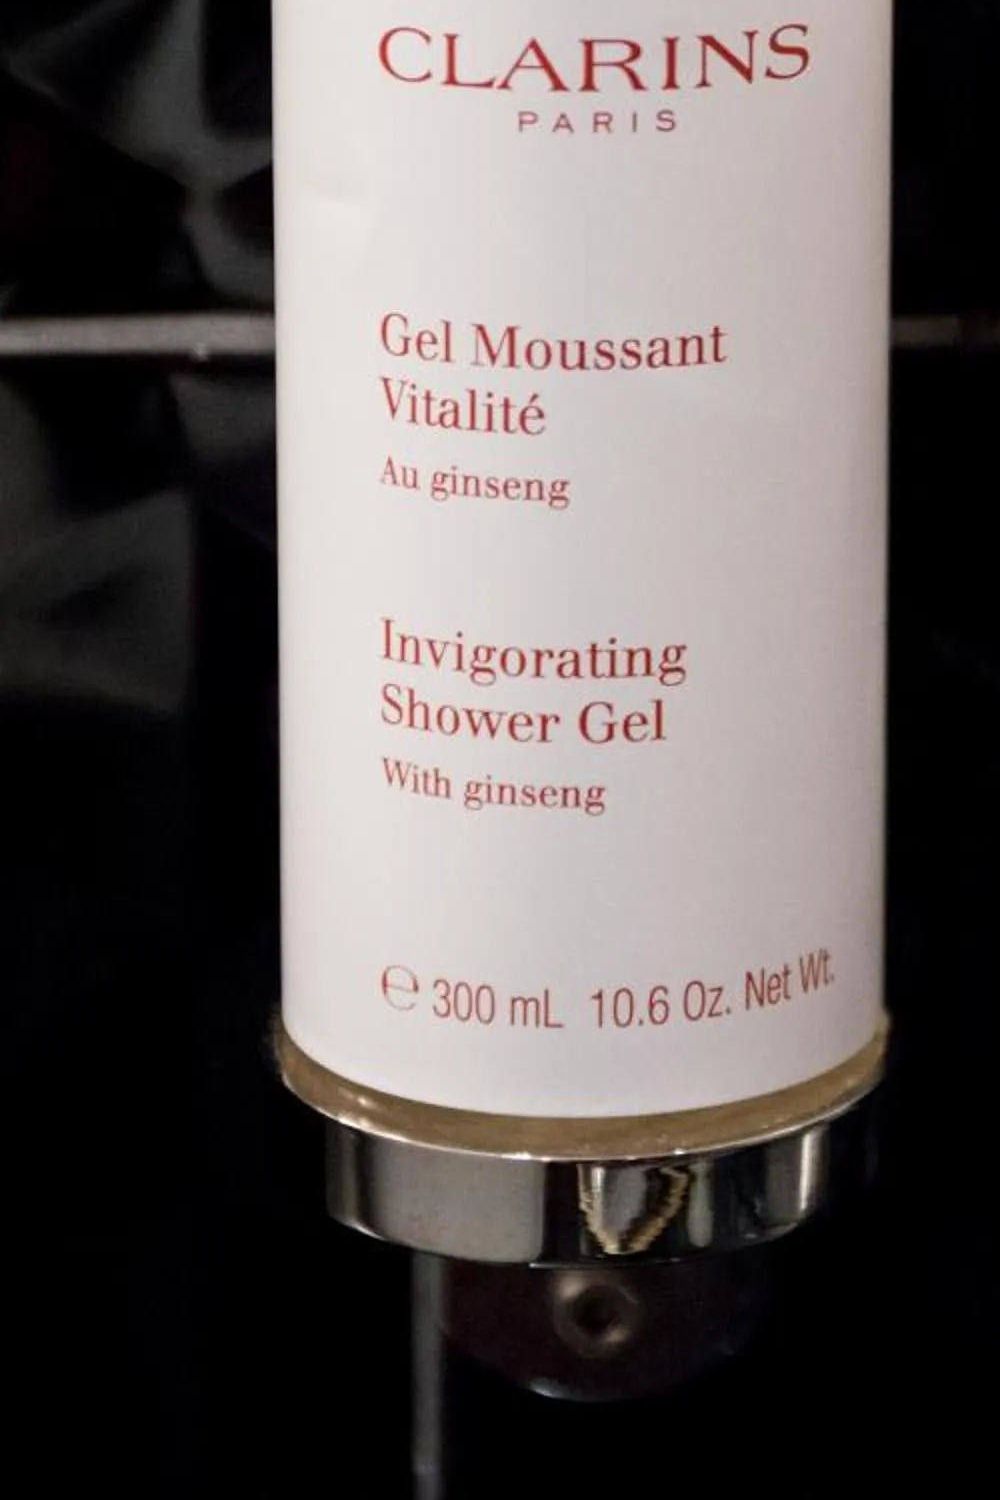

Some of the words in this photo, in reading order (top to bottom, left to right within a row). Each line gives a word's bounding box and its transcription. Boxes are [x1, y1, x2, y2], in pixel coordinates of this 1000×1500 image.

[378, 23, 811, 92] CLARINS
[518, 110, 678, 133] PARIS
[380, 313, 456, 363] Gel
[471, 323, 728, 371] Moussant
[380, 376, 546, 435] Vitalité
[379, 456, 420, 489] Au
[430, 465, 572, 510] ginseng
[380, 617, 688, 686] Invigorating
[380, 683, 561, 742] Shower
[578, 699, 667, 744] Gel
[382, 756, 452, 800] With
[464, 775, 607, 816] ginseng
[432, 979, 496, 1026] 300
[510, 988, 565, 1029] mL
[591, 986, 670, 1029] 10.6
[683, 980, 732, 1023] Oz.
[745, 962, 792, 1011] Net
[799, 948, 836, 994] Wt.
